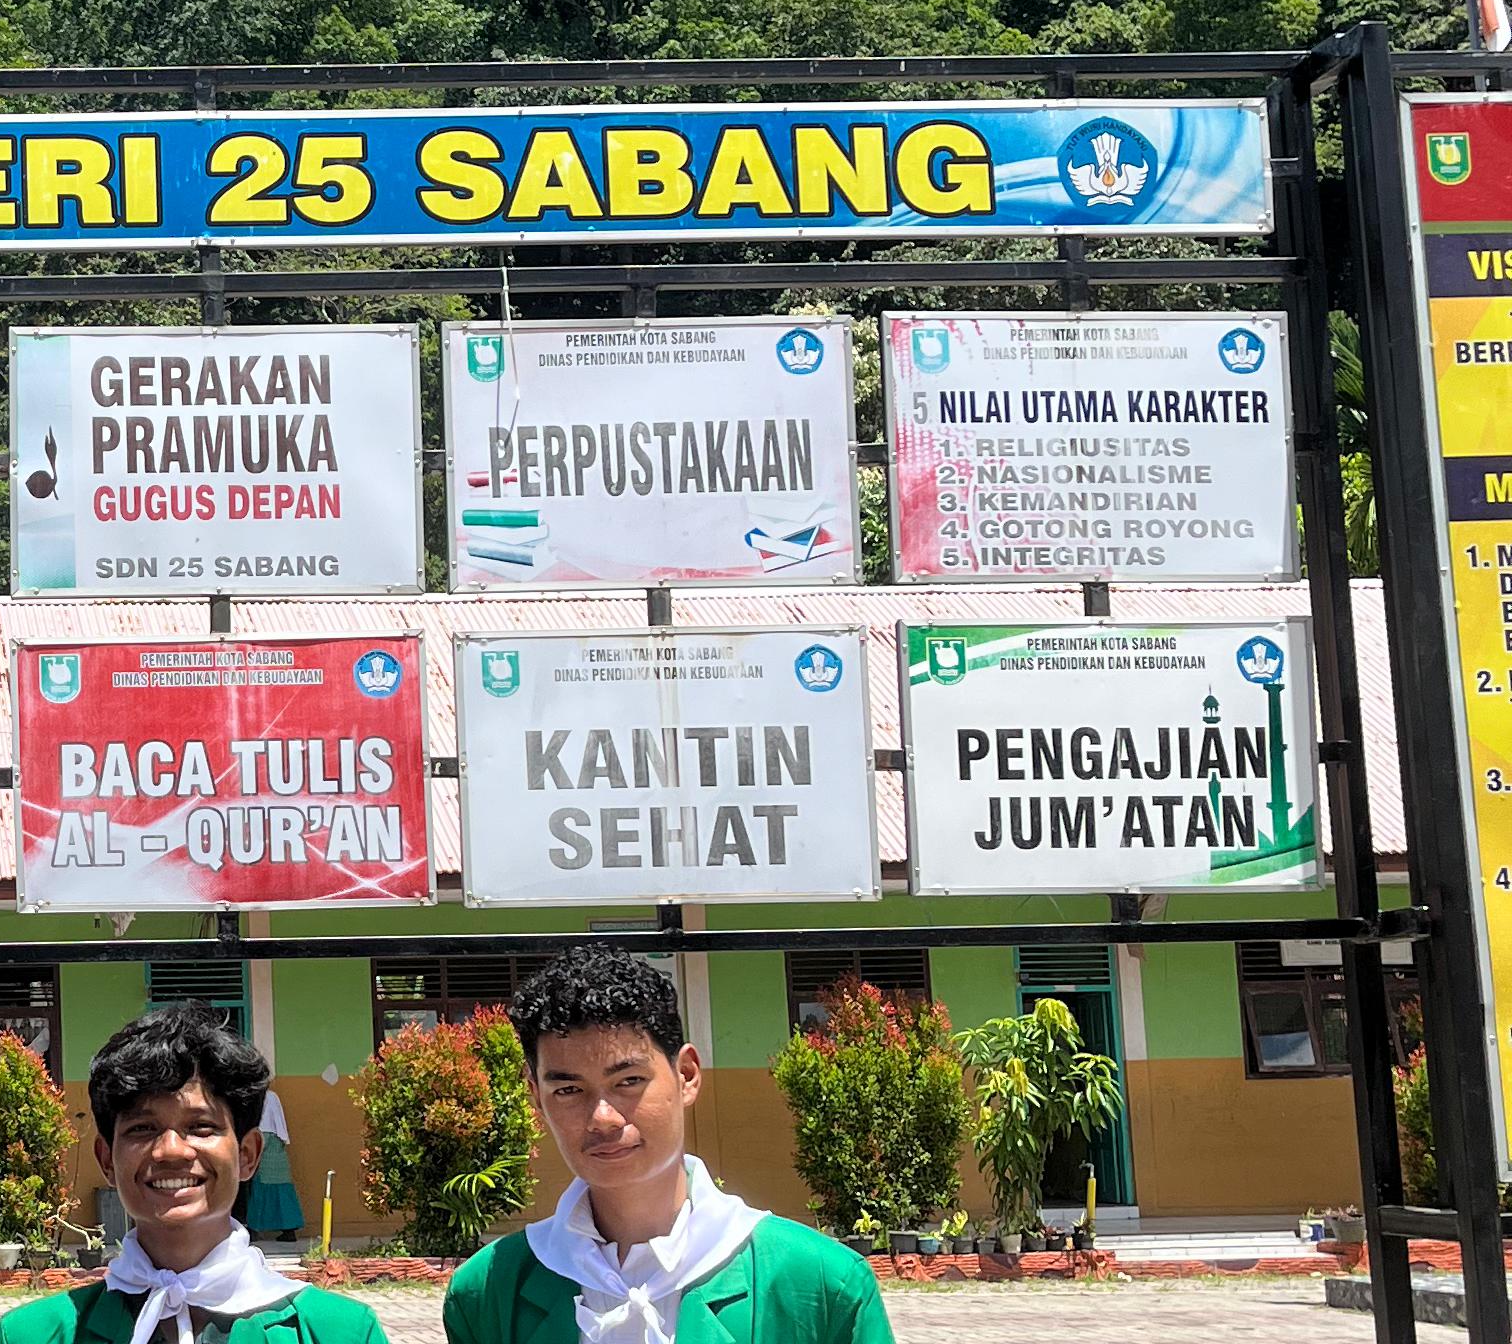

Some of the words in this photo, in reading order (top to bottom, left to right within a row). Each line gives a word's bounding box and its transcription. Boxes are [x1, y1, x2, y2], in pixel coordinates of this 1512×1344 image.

[205, 128, 377, 228] 25
[415, 120, 995, 223] SABANG
[565, 332, 636, 346] PEMERINTAH
[639, 332, 669, 346] KOTA
[671, 331, 716, 345] SABANG
[539, 353, 573, 367] DINAS
[576, 351, 644, 366] PENDIDIKAN
[647, 351, 671, 364] DAN
[673, 349, 745, 363] KEBUDAYAAN
[91, 354, 331, 407] GERAKAN
[913, 391, 927, 425] 5
[939, 391, 1011, 424] NILAI
[1022, 391, 1118, 424] UTAMA
[1128, 390, 1269, 423] KARAKTER
[92, 414, 339, 474] PRAMUKA
[938, 440, 964, 457] 1.
[976, 437, 1190, 458] RELIGIUSITAS
[488, 419, 814, 498] PERPUSTAKAAN
[938, 466, 965, 484] 2.
[977, 465, 1212, 484] NASIONALISME
[93, 484, 216, 522] GUGUS
[228, 484, 341, 520] DEPAN
[938, 493, 967, 511] 3.
[978, 492, 1197, 511] KEMANDIRIAN
[939, 521, 968, 539] 4.
[979, 520, 1112, 539] GOTONG
[1123, 519, 1254, 538] ROYONG
[96, 557, 157, 578] SDN
[169, 557, 204, 577] 25
[214, 556, 339, 577] SABANG
[942, 548, 969, 567] 5.
[981, 547, 1166, 567] INTEGRITAS
[1466, 545, 1489, 567] 1.
[582, 649, 653, 663] PEMERINTAH
[657, 648, 685, 662] KOTA
[688, 647, 733, 661] SABANG
[1027, 638, 1098, 651] PEMERINTAH
[1101, 638, 1129, 651] KOTA
[1131, 637, 1177, 651] SABANG
[140, 653, 213, 667] PEMERINTAH
[216, 653, 245, 666] KOTA
[248, 652, 294, 666] SABANG
[1000, 657, 1034, 671] DINAS
[1038, 657, 1105, 670] PENDIDIKAN
[1108, 657, 1131, 670] DAN
[1134, 656, 1205, 670] KEBUDAYAAN
[113, 673, 148, 687] DINAS
[151, 672, 220, 686] PENDIDIKAN
[222, 672, 246, 685] DAN
[249, 670, 322, 685] KEBUDAYAAN
[554, 668, 589, 682] DINAS
[592, 667, 661, 681] PENDIDIKAN
[664, 666, 687, 680] DAN
[690, 665, 763, 679] KEBUDAYAAN
[524, 725, 811, 790] KANTIN
[957, 725, 1268, 781] PENGAJIAN
[61, 739, 217, 798] BACA
[231, 736, 394, 796] TULIS
[974, 794, 1255, 850] JUM'ATAN
[51, 808, 125, 868] AL
[186, 805, 402, 872] QUR'AN
[548, 804, 799, 870] SEHAT
